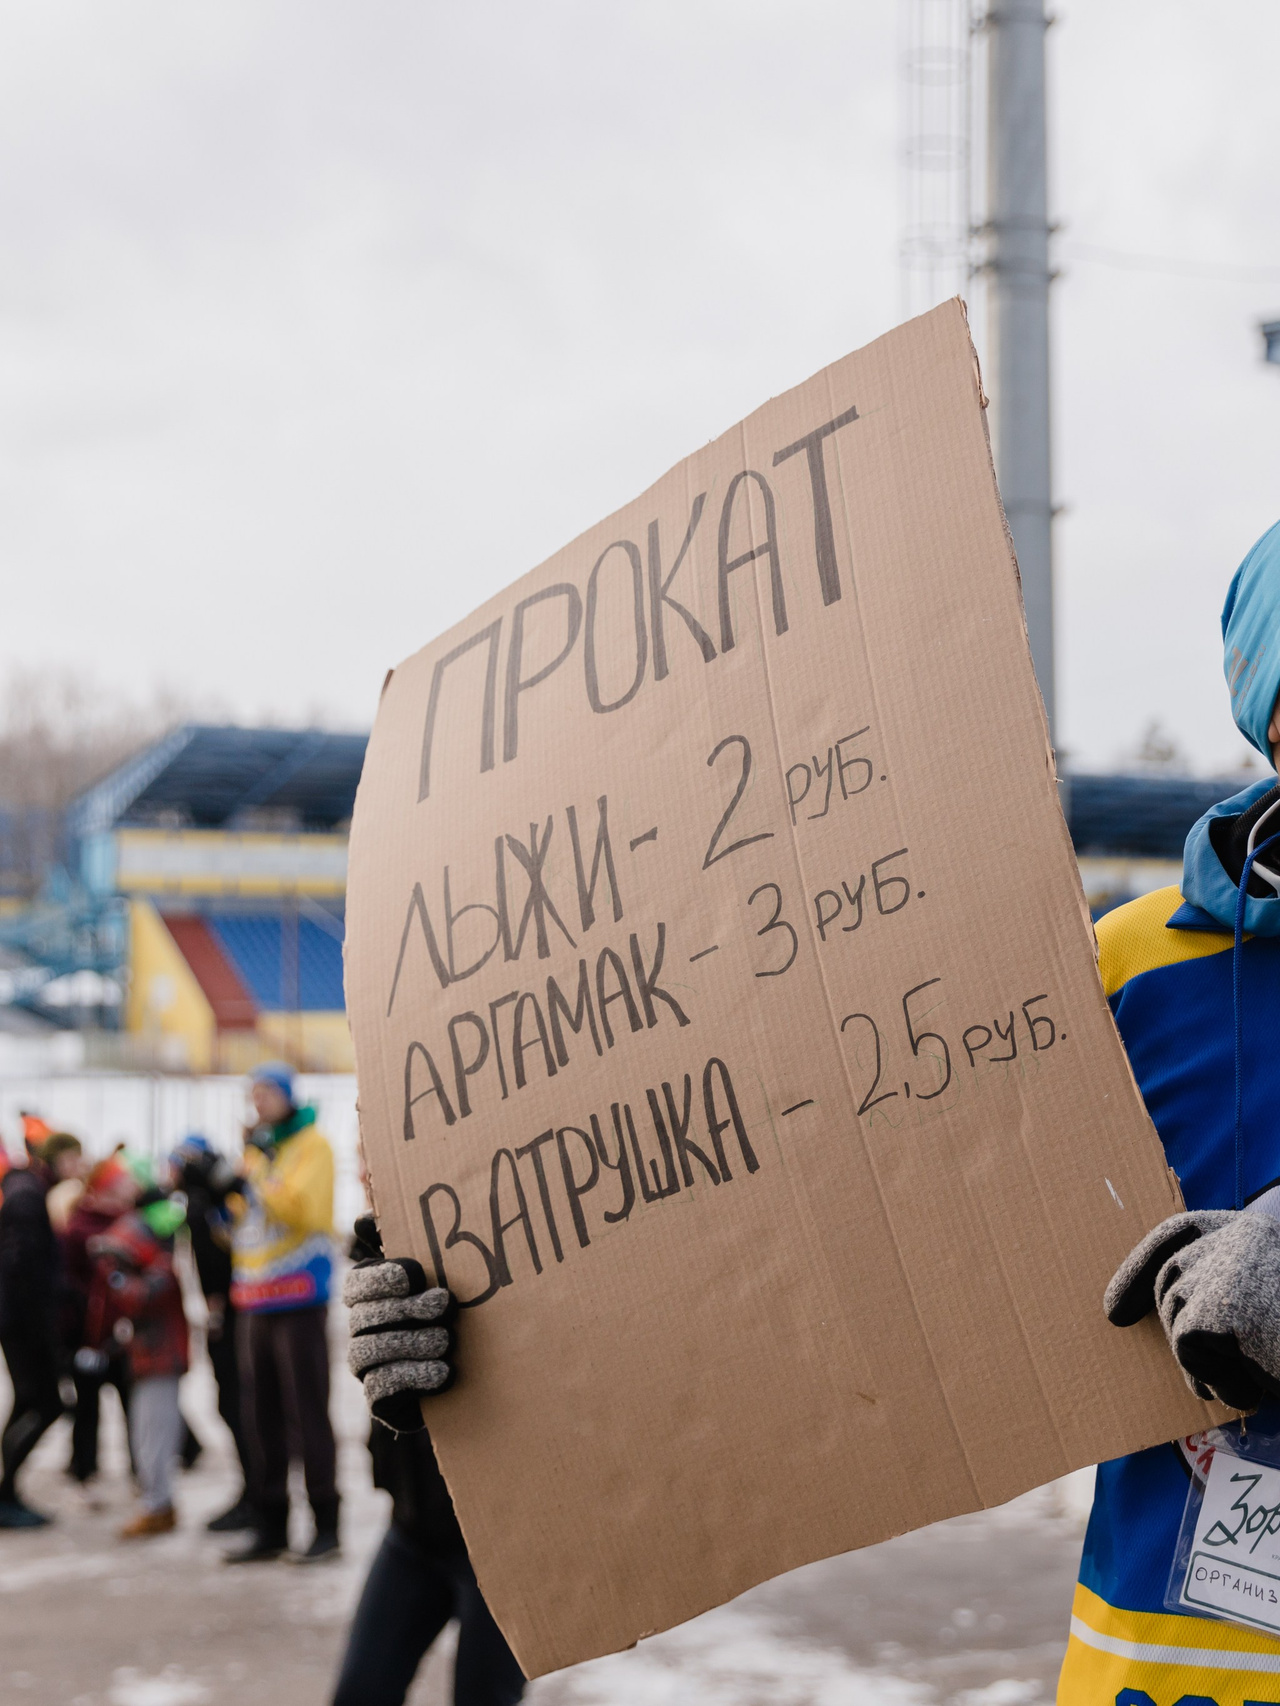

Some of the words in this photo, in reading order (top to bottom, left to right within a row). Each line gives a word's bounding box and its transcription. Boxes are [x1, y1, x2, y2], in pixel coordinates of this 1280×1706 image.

[417, 405, 860, 803] ПРОКАТ
[1234, 643, 1267, 725] ORDSKI
[702, 734, 775, 870] 2
[403, 922, 691, 1141] АРГАМАК
[748, 883, 799, 978] 3
[418, 1056, 761, 1309] ВАТРУШКА
[840, 977, 952, 1116] 2,5
